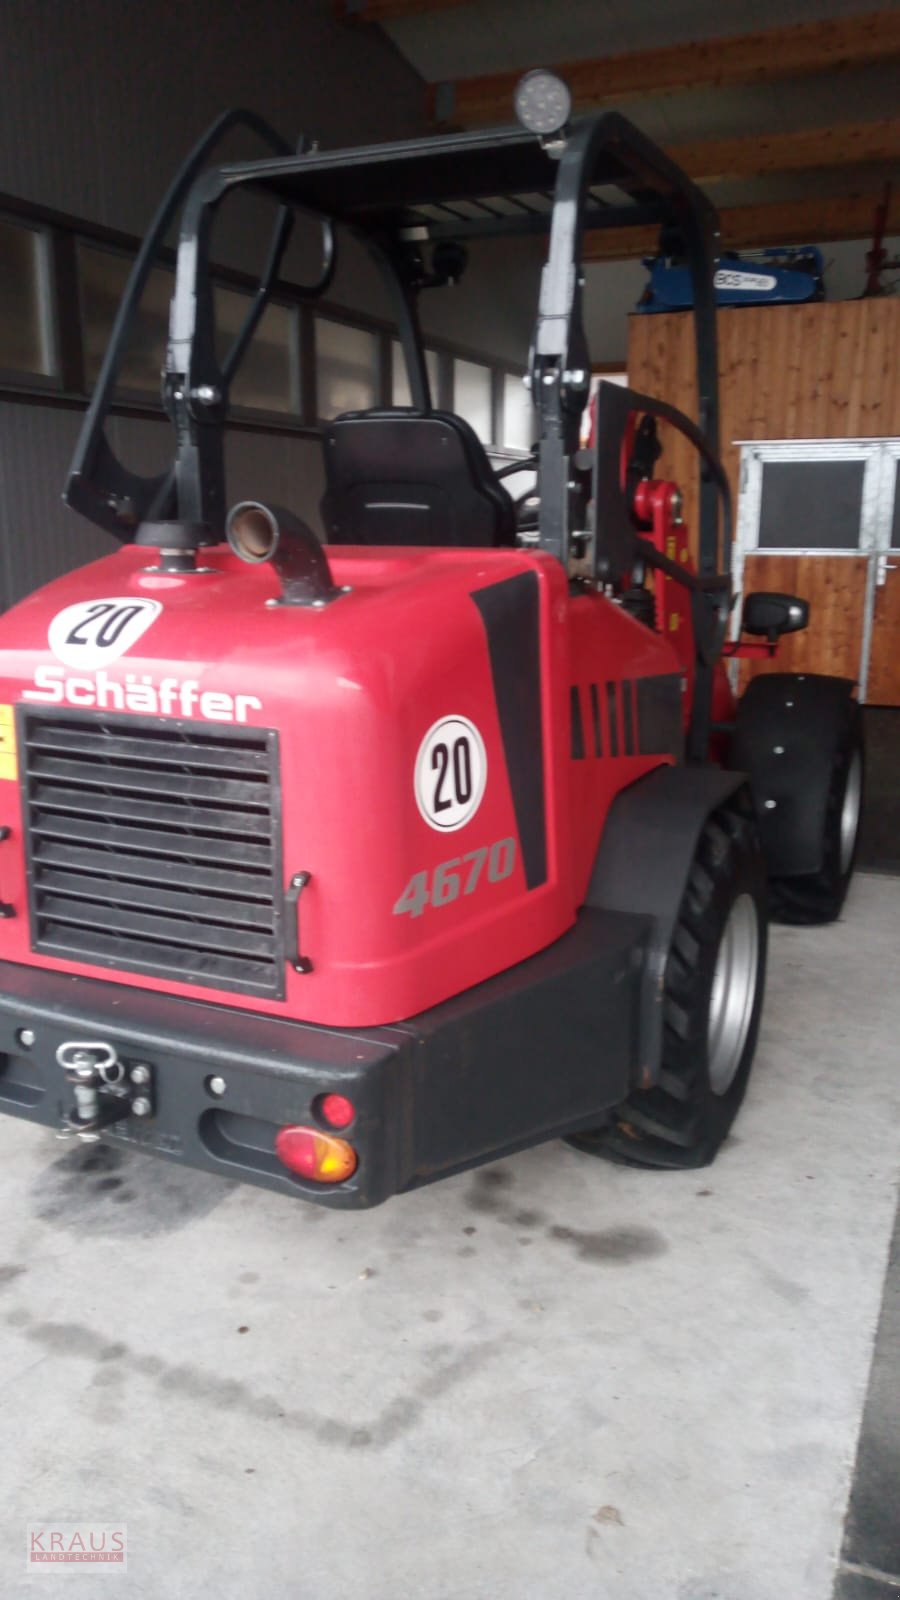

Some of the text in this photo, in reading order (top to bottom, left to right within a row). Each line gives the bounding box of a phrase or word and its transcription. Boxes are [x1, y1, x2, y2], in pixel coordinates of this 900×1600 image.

[65, 603, 144, 648] 20
[22, 665, 262, 722] Schäffer
[431, 736, 472, 813] 20
[392, 837, 516, 918] 4670
